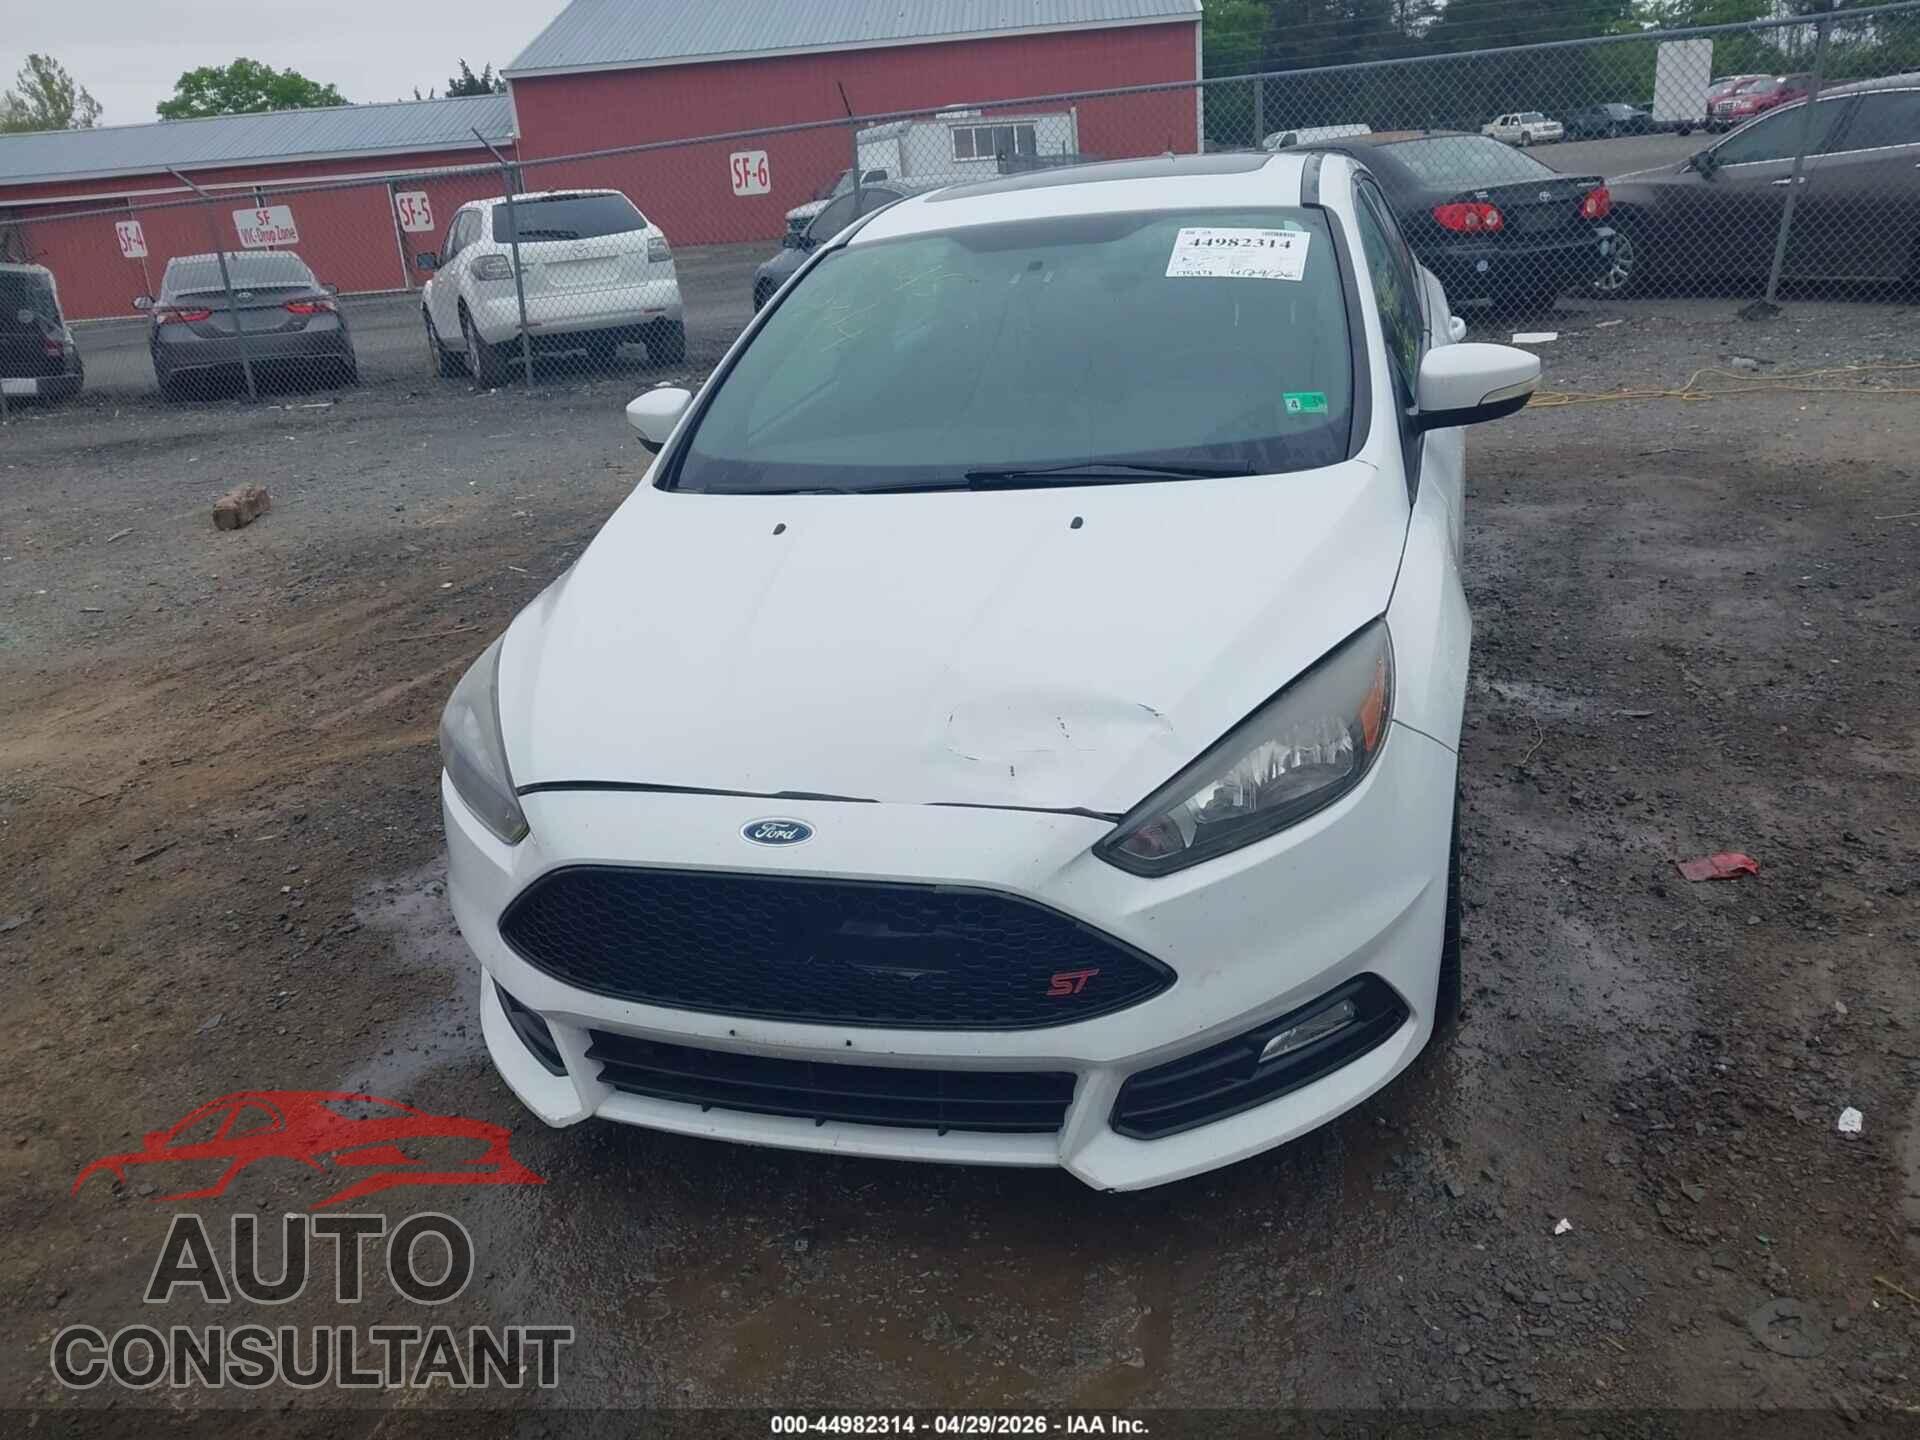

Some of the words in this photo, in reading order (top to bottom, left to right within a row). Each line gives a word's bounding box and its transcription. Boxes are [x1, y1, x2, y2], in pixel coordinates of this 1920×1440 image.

[733, 157, 768, 189] SF-6
[256, 209, 271, 226] SF
[400, 197, 431, 226] SF-5
[118, 226, 145, 252] SF-4
[275, 224, 297, 241] Zone
[1188, 237, 1291, 249] 44982314
[755, 822, 799, 840] Ford
[1046, 967, 1100, 996] ST
